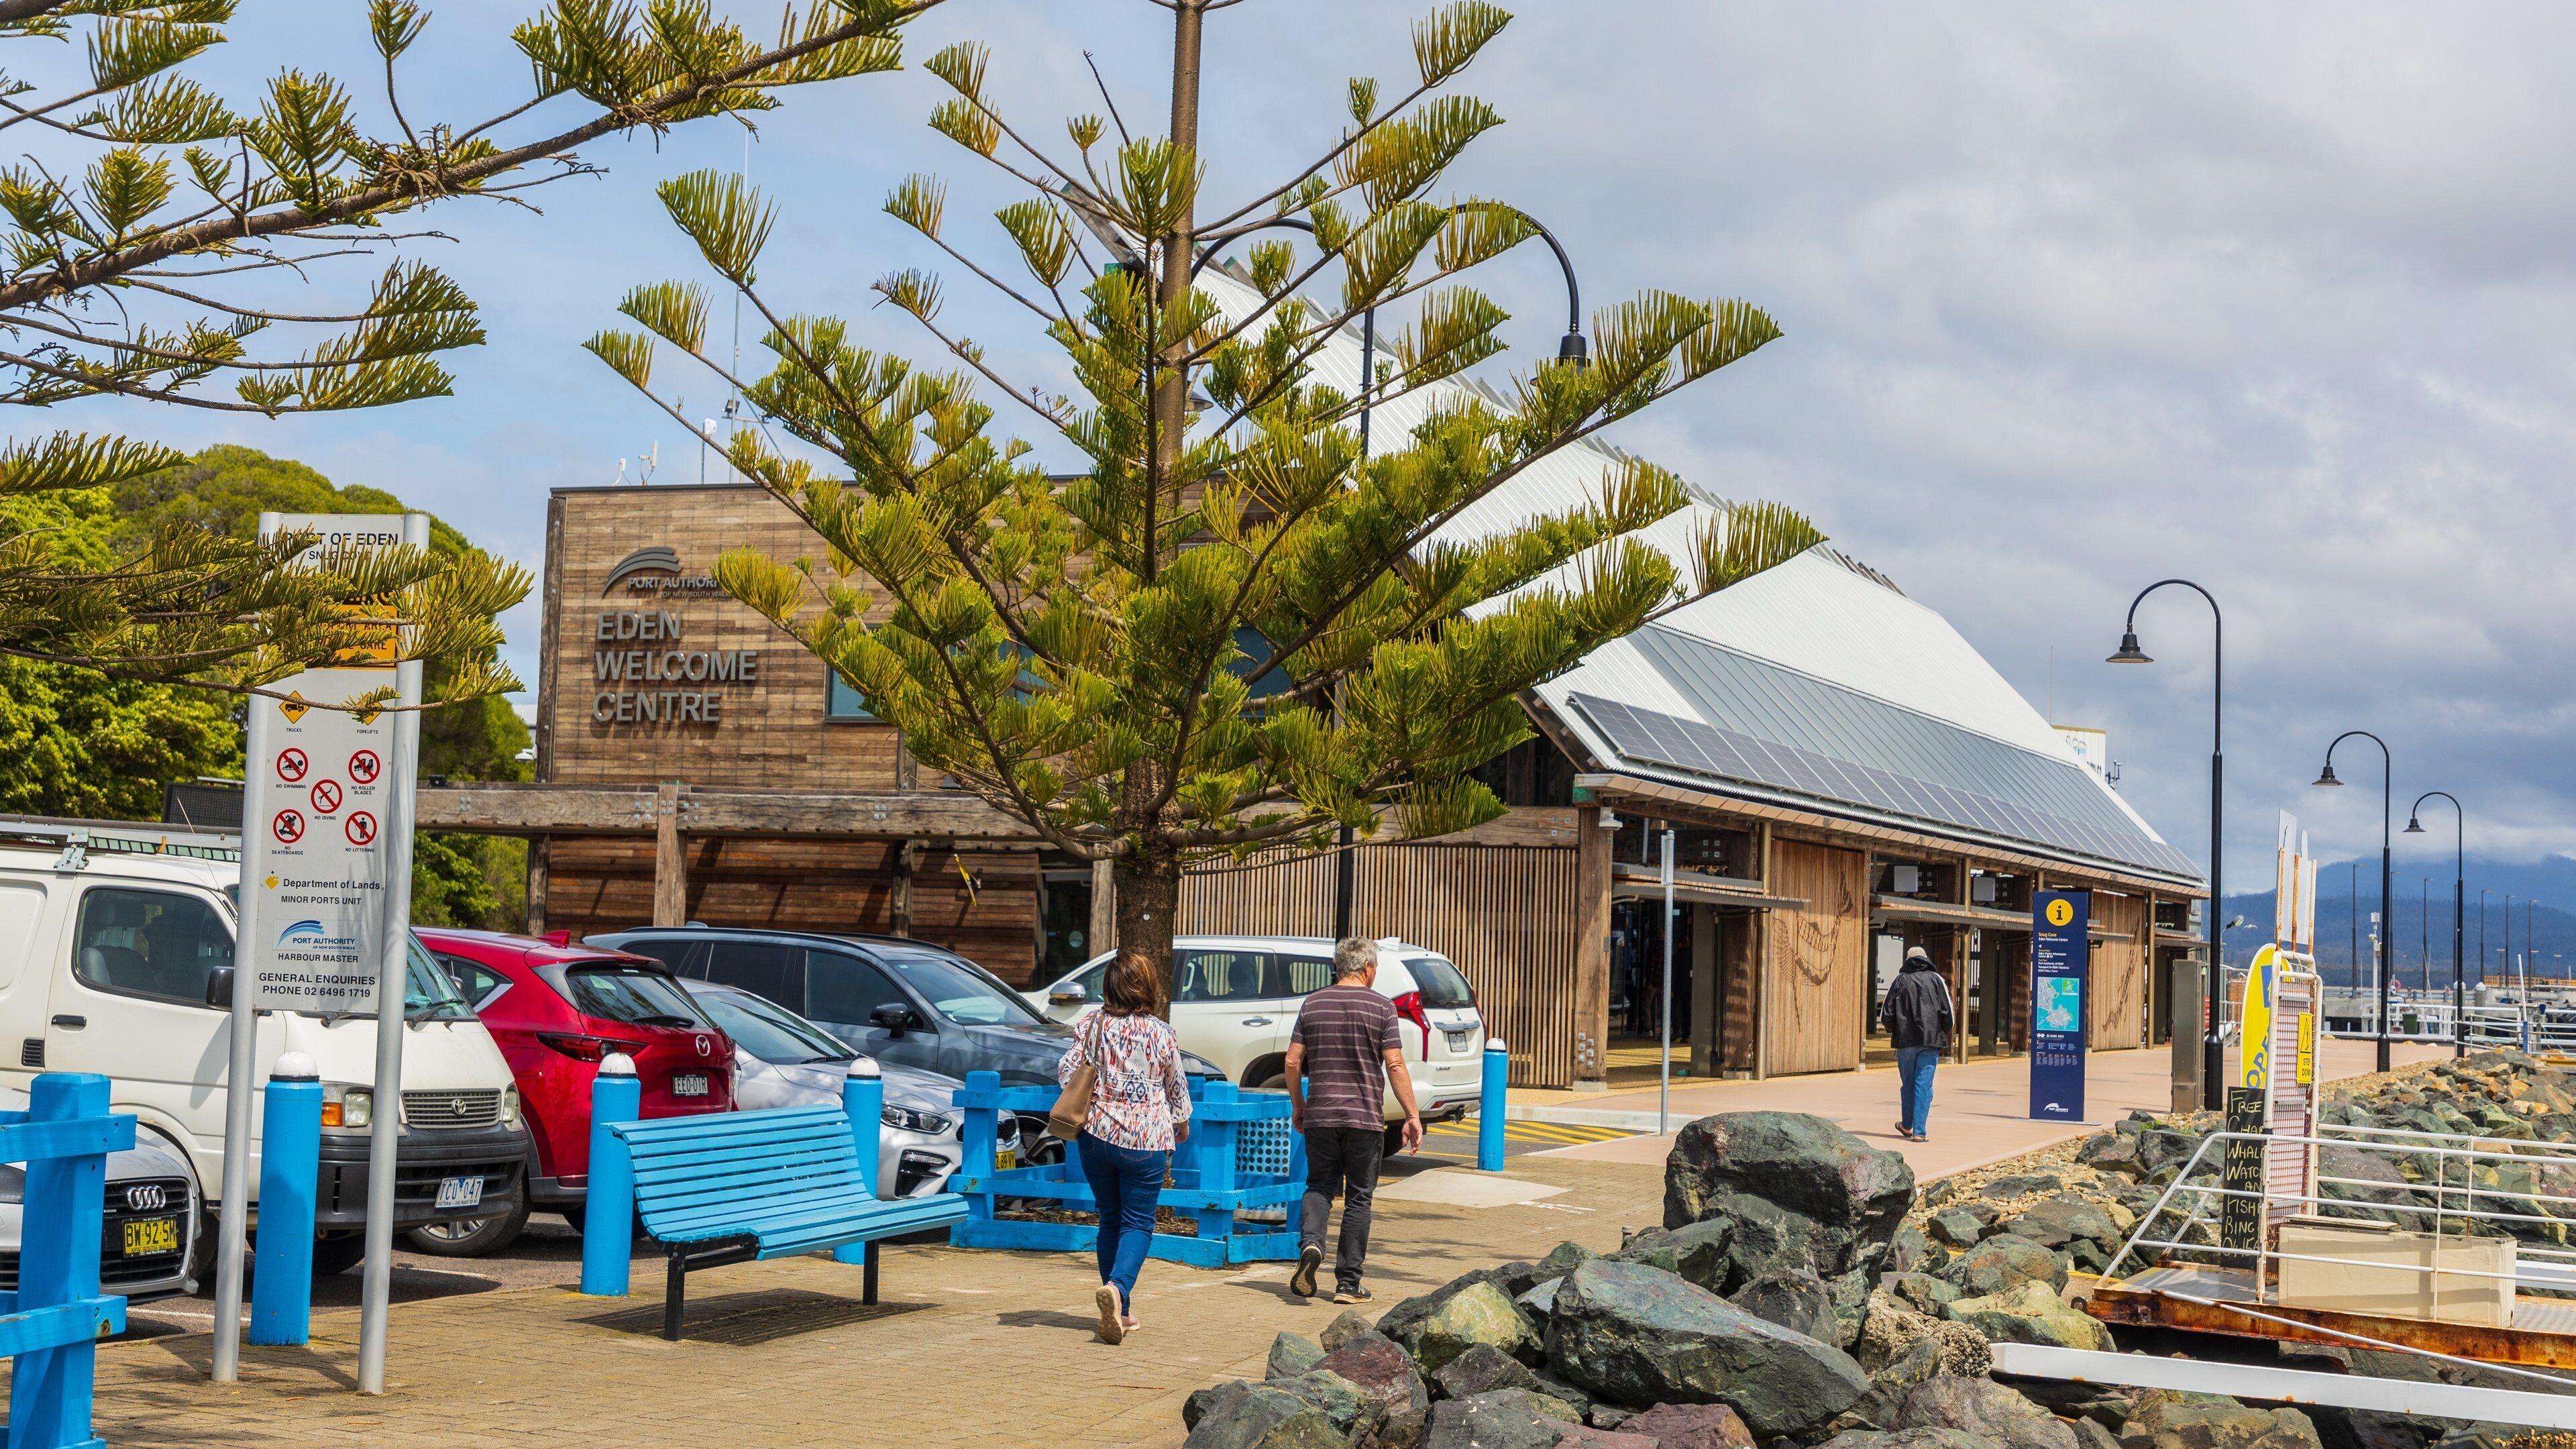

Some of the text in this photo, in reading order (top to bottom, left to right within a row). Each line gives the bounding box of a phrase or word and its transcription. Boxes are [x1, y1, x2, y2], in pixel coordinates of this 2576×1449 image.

[285, 533, 398, 545] PT OF EDEN
[628, 576, 717, 588] PORT AUTHORI
[597, 610, 682, 640] EDEN
[595, 651, 757, 681] WELCOME
[593, 692, 721, 722] CENTRE
[283, 878, 380, 890] Department of Lands
[281, 896, 309, 904] MINOR
[278, 953, 359, 963] HARBOUR MASTER
[259, 973, 376, 985] GENERAL ENQUIRIES
[262, 985, 370, 998] PHONE 02 6496 1719
[2231, 1090, 2263, 1113] FREE
